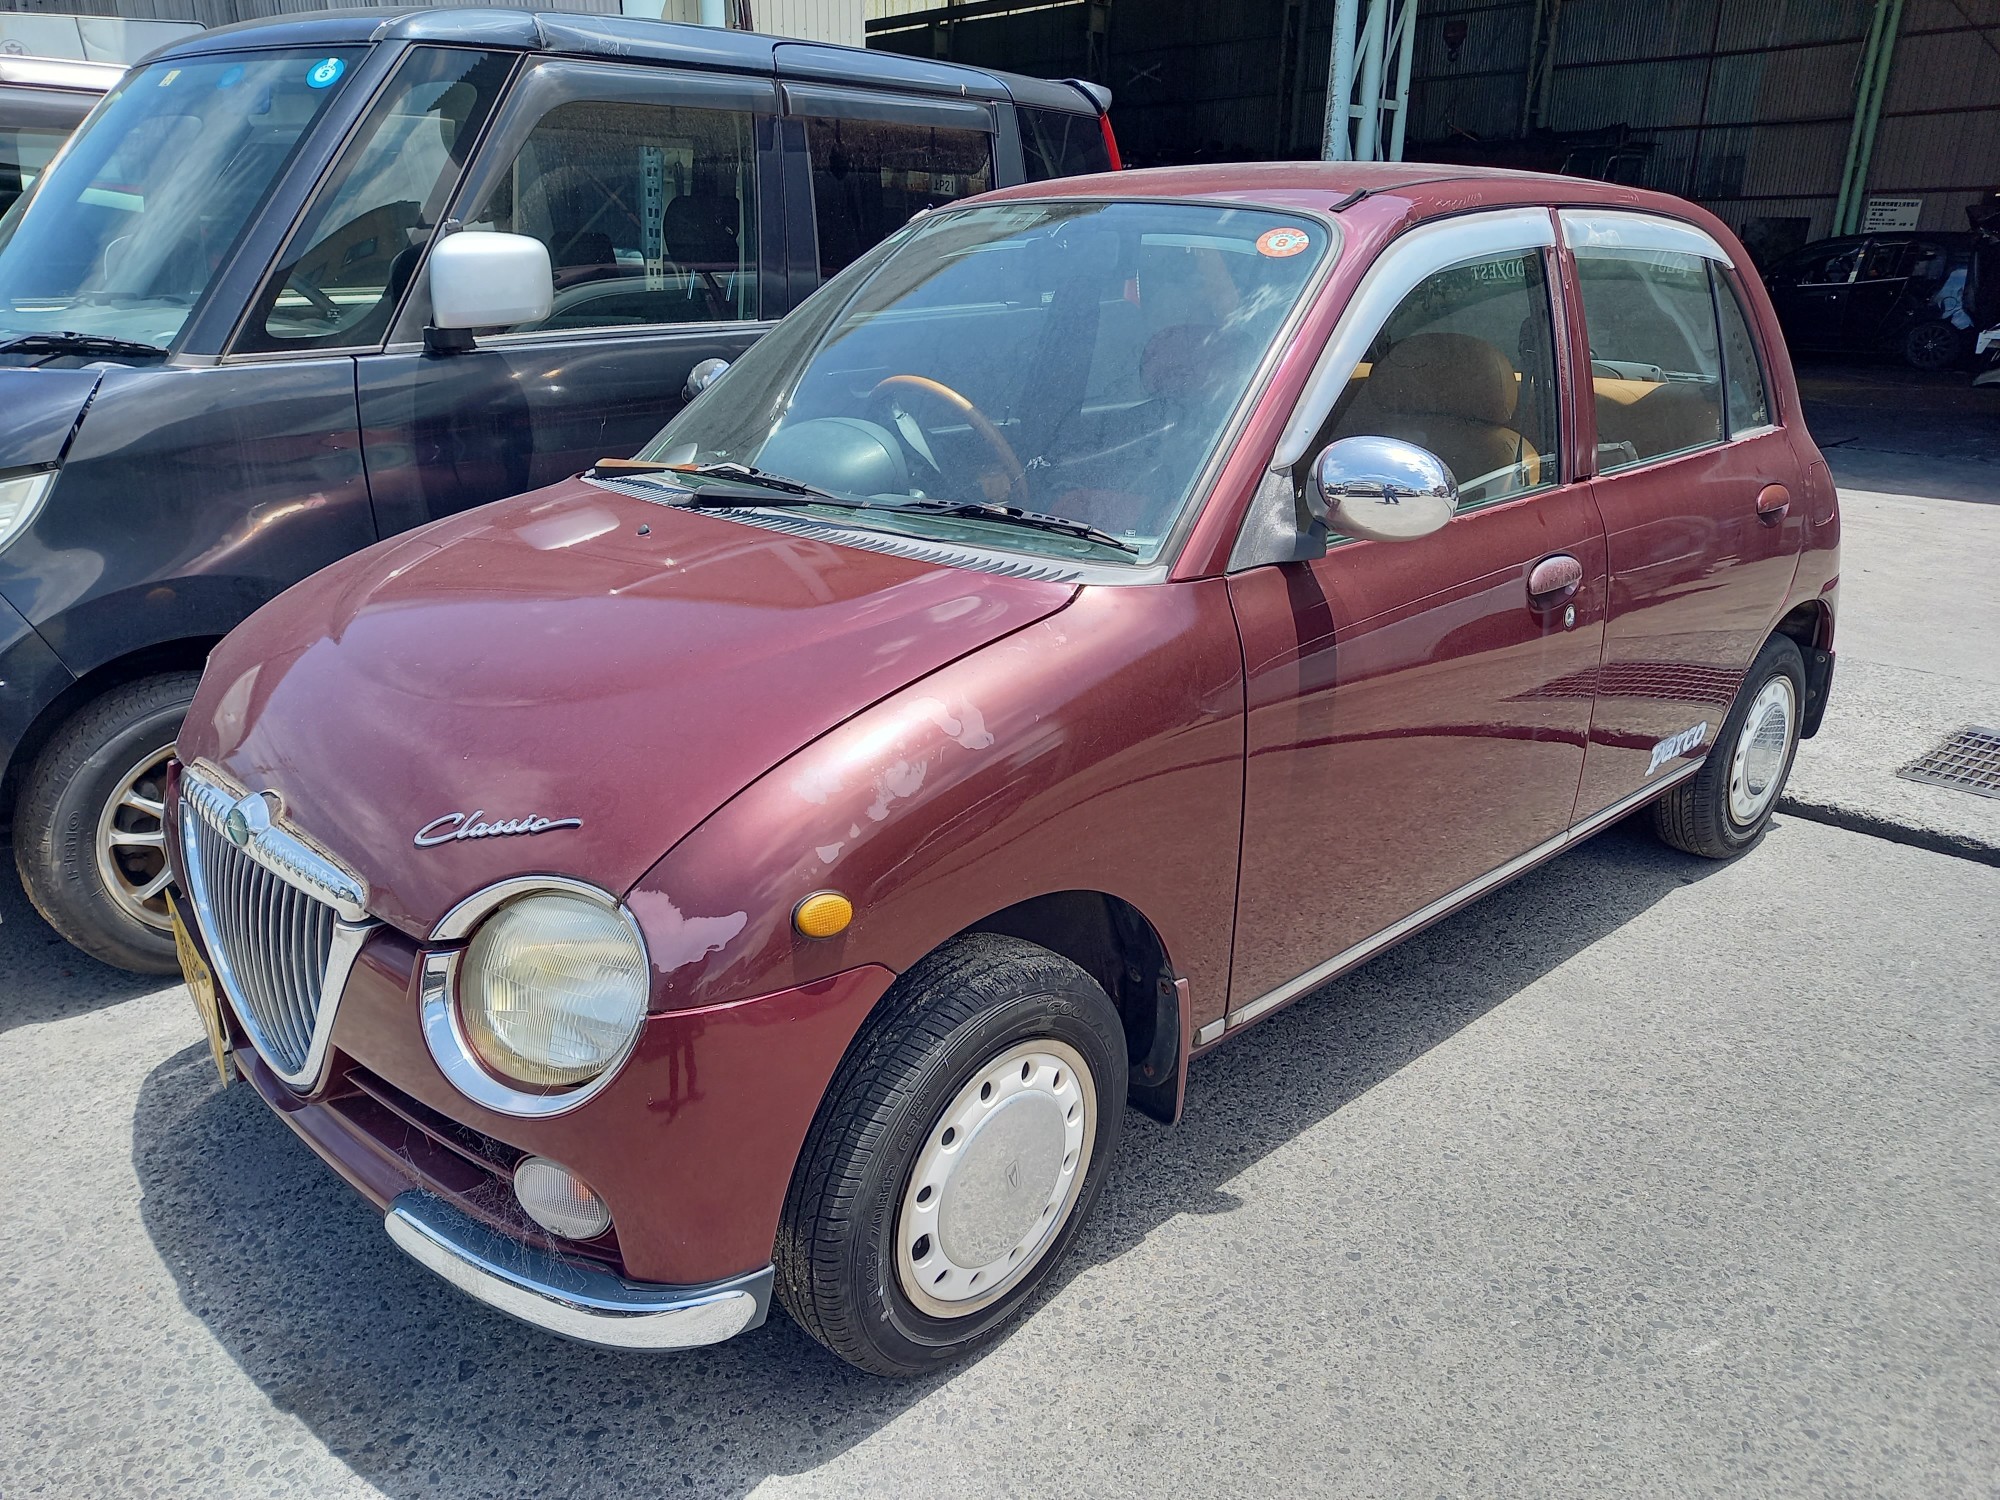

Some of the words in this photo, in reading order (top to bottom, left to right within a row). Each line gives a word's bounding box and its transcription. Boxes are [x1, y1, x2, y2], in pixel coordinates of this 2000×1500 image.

[319, 69, 330, 78] 5
[1275, 238, 1289, 248] 8
[1644, 720, 1708, 777] parco
[413, 809, 584, 848] Classic
